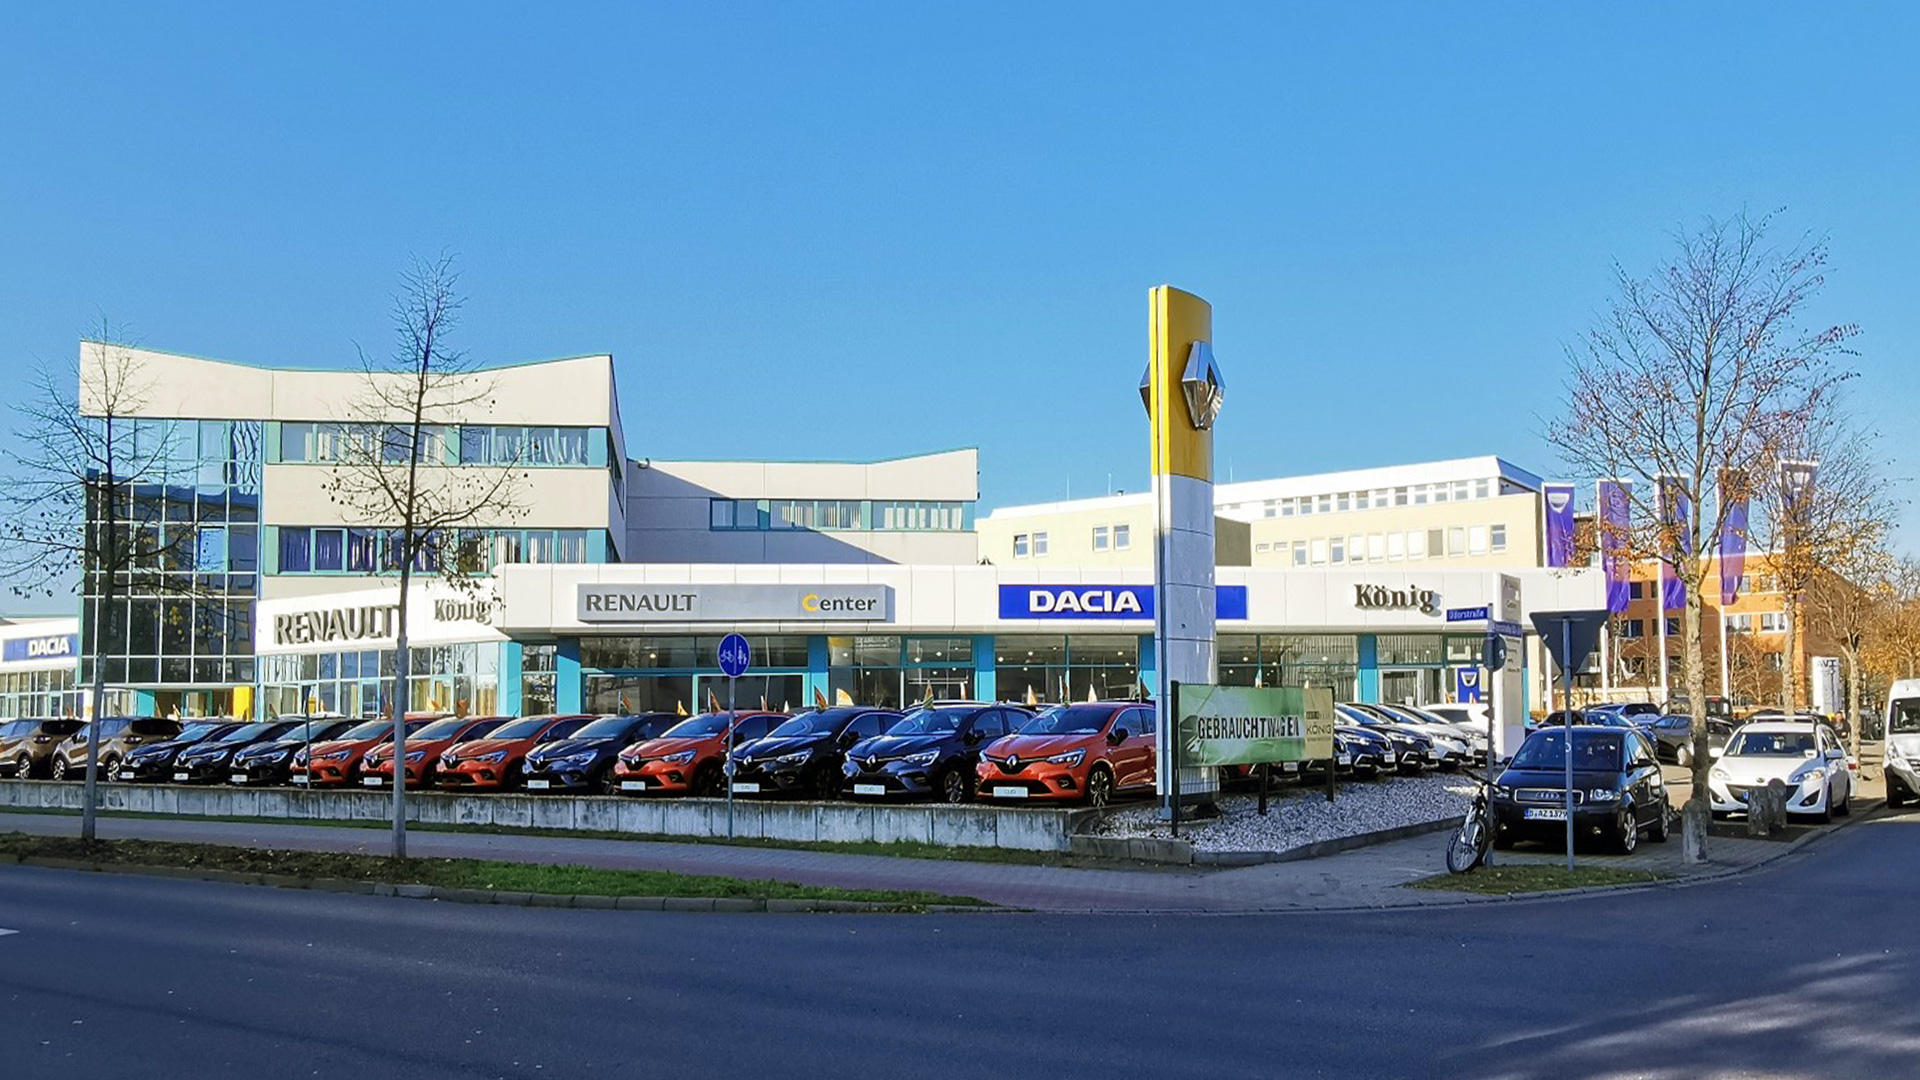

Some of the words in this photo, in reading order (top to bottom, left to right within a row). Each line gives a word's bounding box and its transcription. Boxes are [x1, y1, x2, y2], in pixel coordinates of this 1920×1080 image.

[585, 594, 698, 612] RENAULT
[801, 593, 877, 612] Center
[1028, 590, 1142, 612] DACIA
[1353, 584, 1434, 613] König
[273, 604, 399, 645] RENAULT
[434, 598, 493, 626] König
[28, 637, 70, 657] DACIA
